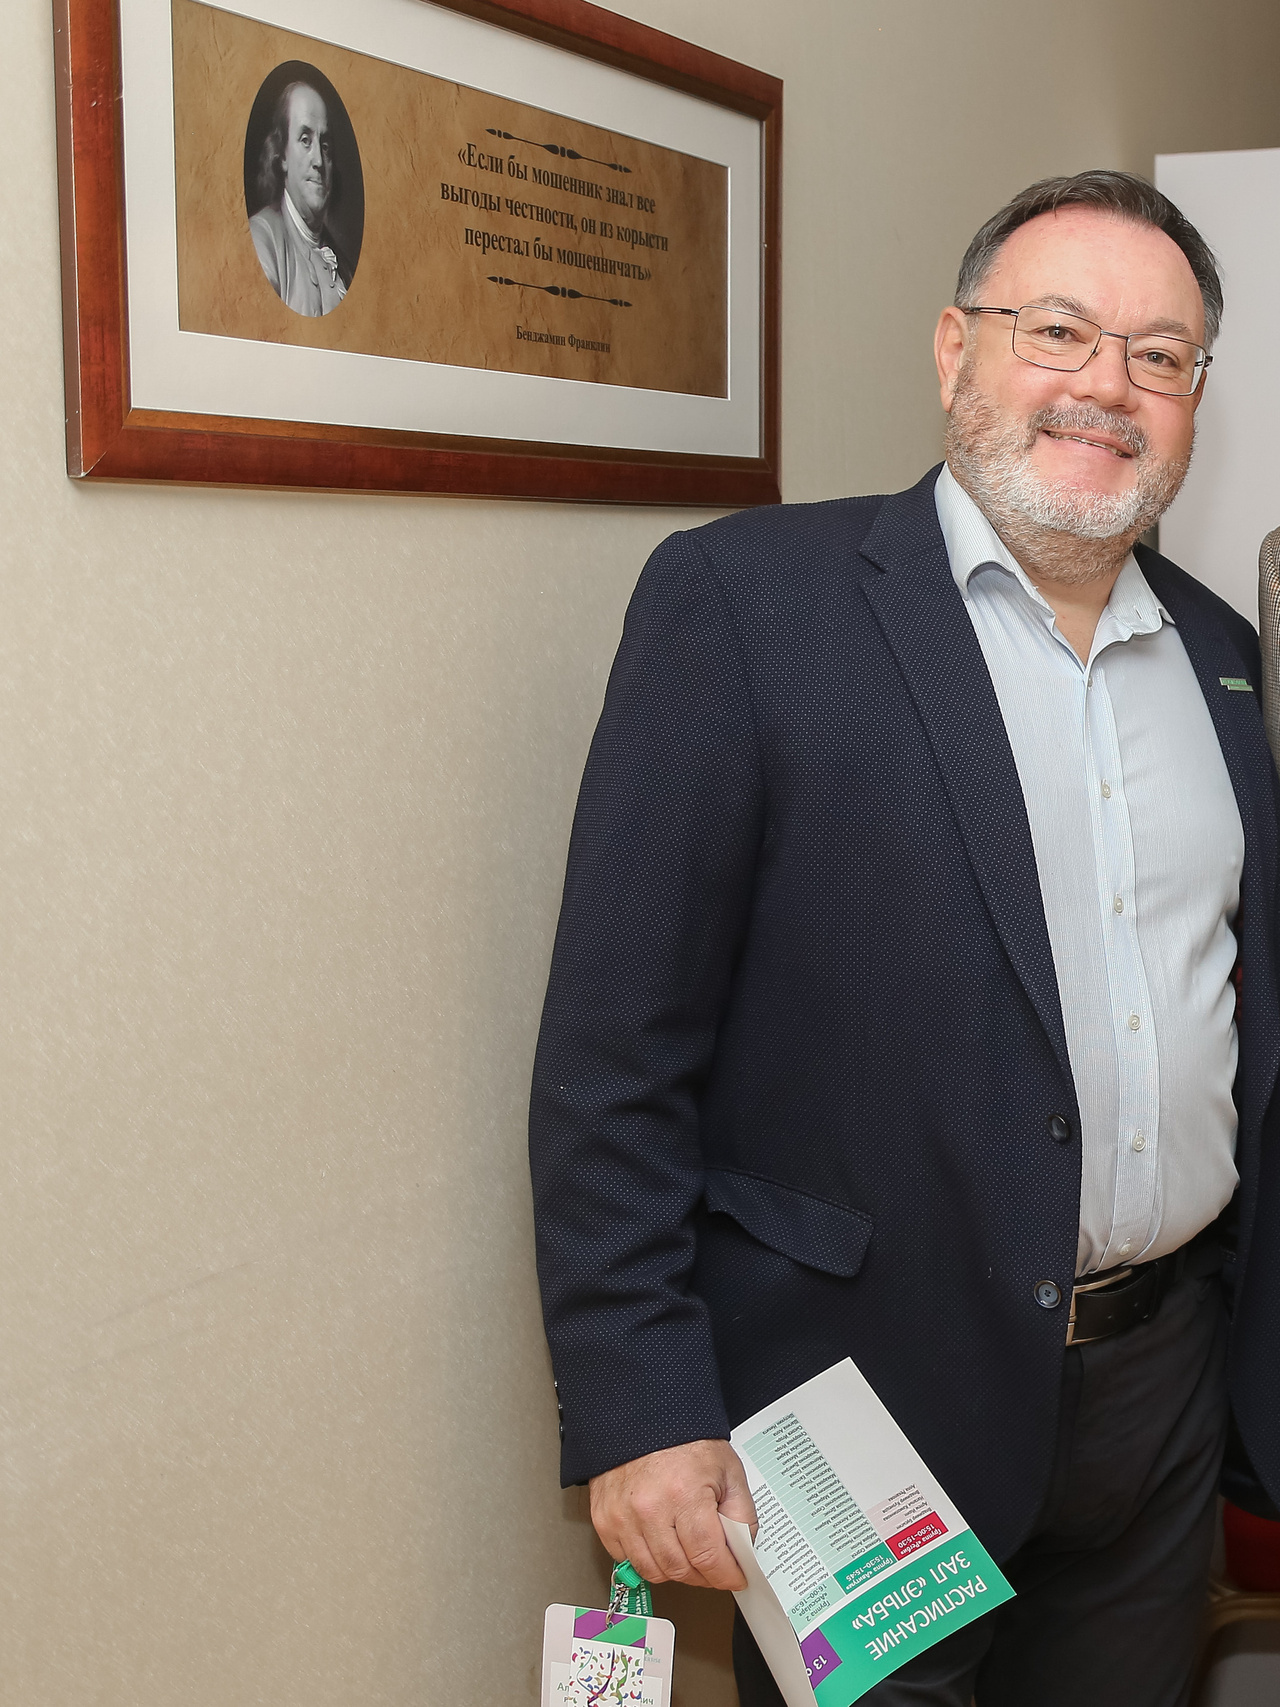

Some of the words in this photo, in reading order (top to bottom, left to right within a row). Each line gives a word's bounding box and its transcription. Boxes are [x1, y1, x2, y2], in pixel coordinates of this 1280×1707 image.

[458, 142, 503, 174] «Если
[508, 154, 528, 180] бы
[532, 167, 602, 200] мошенник
[606, 184, 633, 208] знал
[636, 194, 656, 214] все
[441, 182, 500, 212] выгоды
[505, 199, 578, 234] честности,
[581, 216, 596, 235] он
[600, 220, 613, 239] из
[617, 226, 668, 251] корысти
[464, 228, 530, 257] перестал
[534, 237, 552, 262] бы
[557, 248, 651, 281] мошенничать»
[516, 326, 566, 346] Бенджамин
[568, 333, 610, 353] Франклин
[921, 1527, 942, 1542] Группа
[873, 1557, 893, 1572] Группа
[929, 1550, 971, 1584] ЗАЛ
[810, 1600, 830, 1616] Группа
[852, 1577, 927, 1630] «ЭЛЬБА»
[865, 1575, 987, 1660] РАСПИСАНИЕ
[813, 1655, 828, 1670] 13
